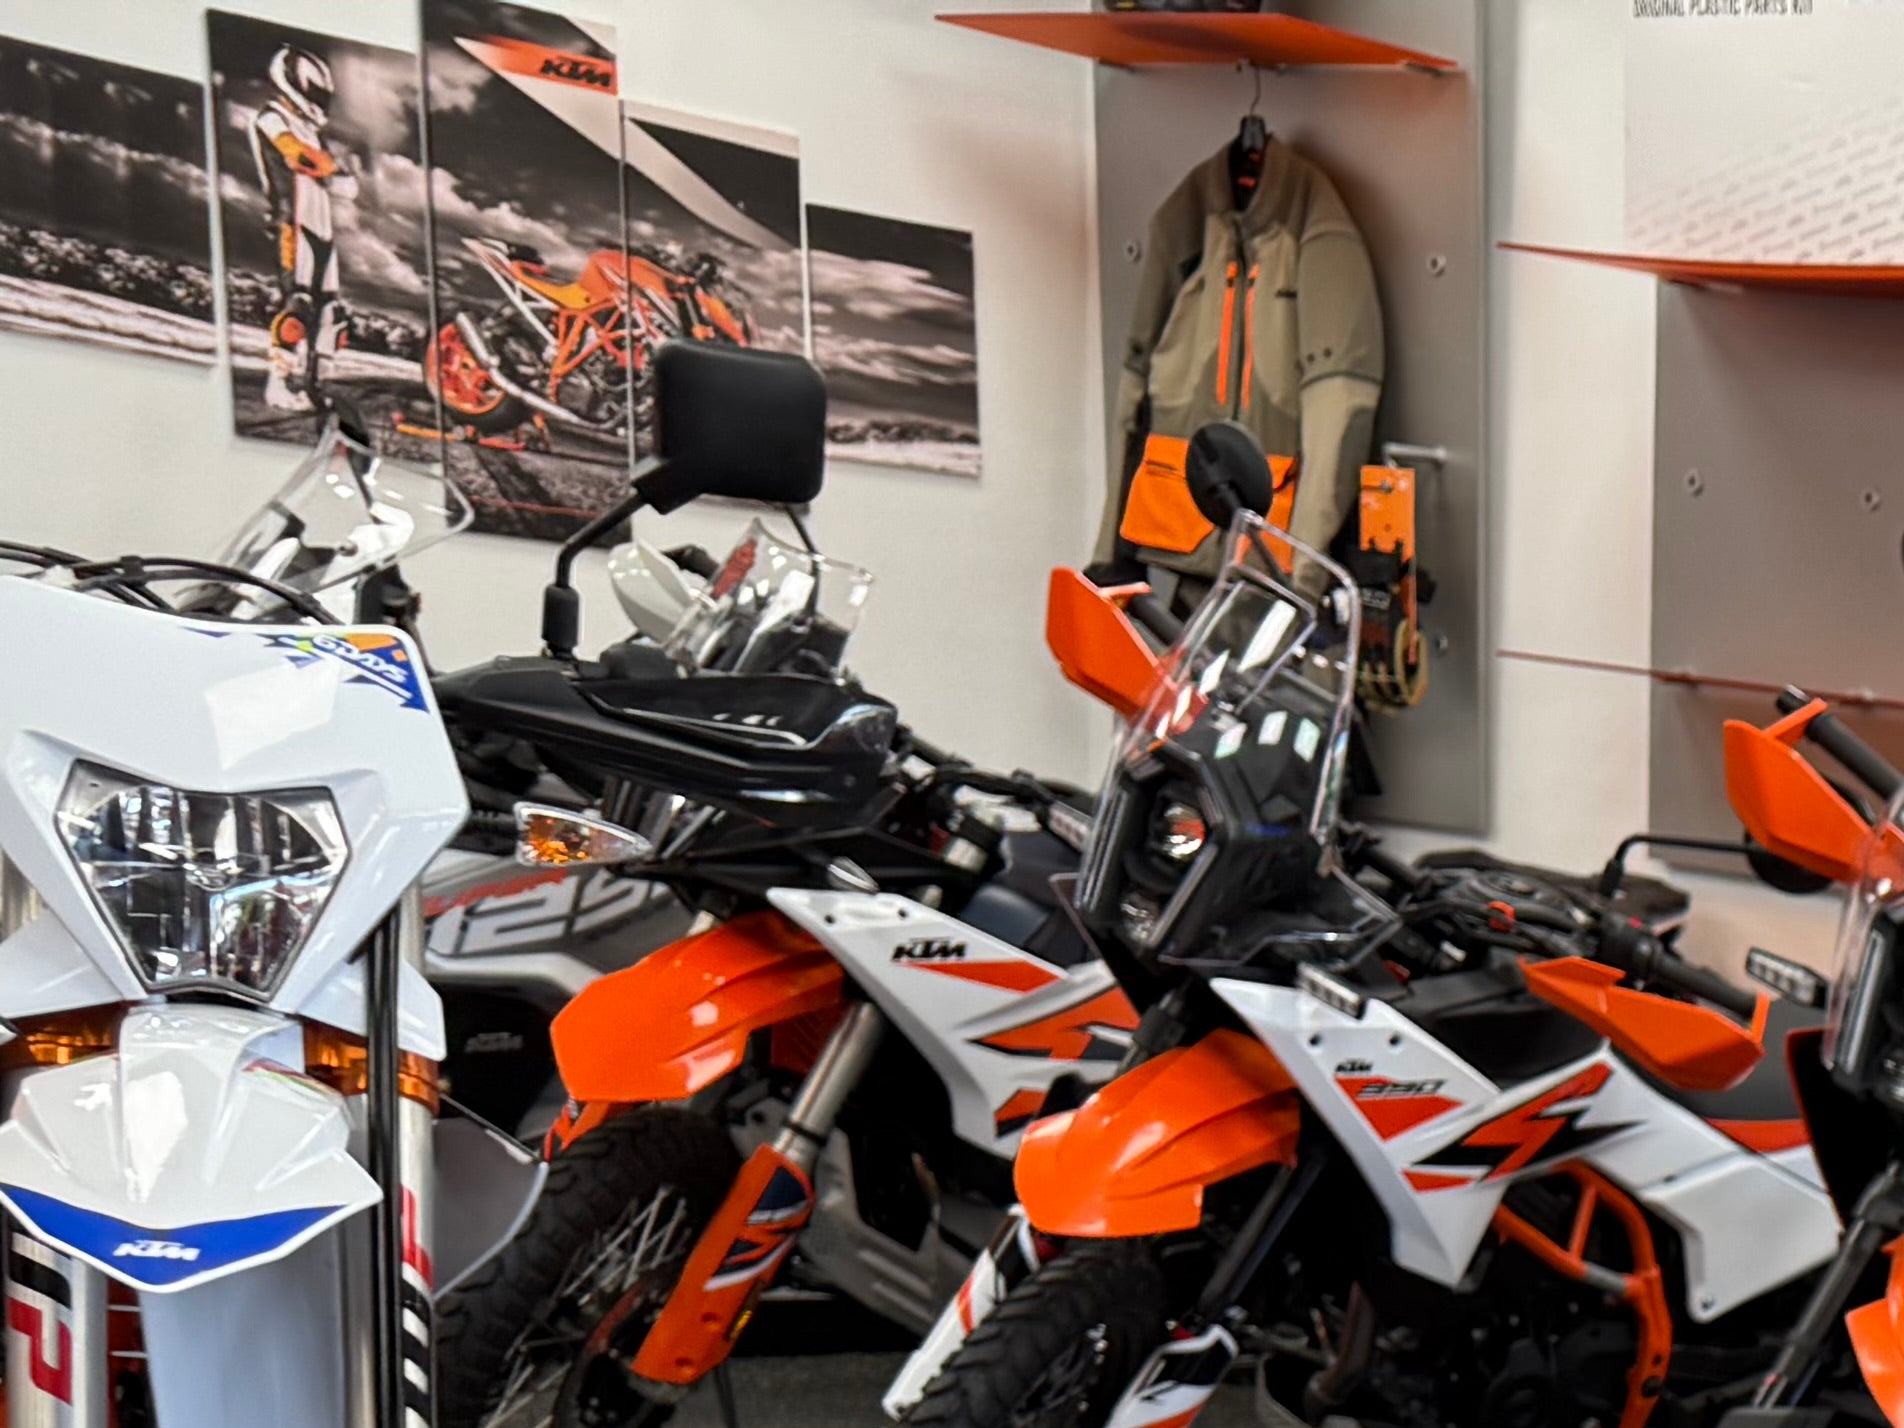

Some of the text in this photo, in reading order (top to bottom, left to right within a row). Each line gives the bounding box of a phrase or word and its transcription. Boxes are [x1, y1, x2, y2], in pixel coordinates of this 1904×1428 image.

[540, 57, 612, 88] KTM
[312, 634, 410, 684] 6DAYS
[889, 935, 966, 961] KTM
[1335, 1058, 1373, 1073] KTM
[112, 1239, 201, 1262] KTM
